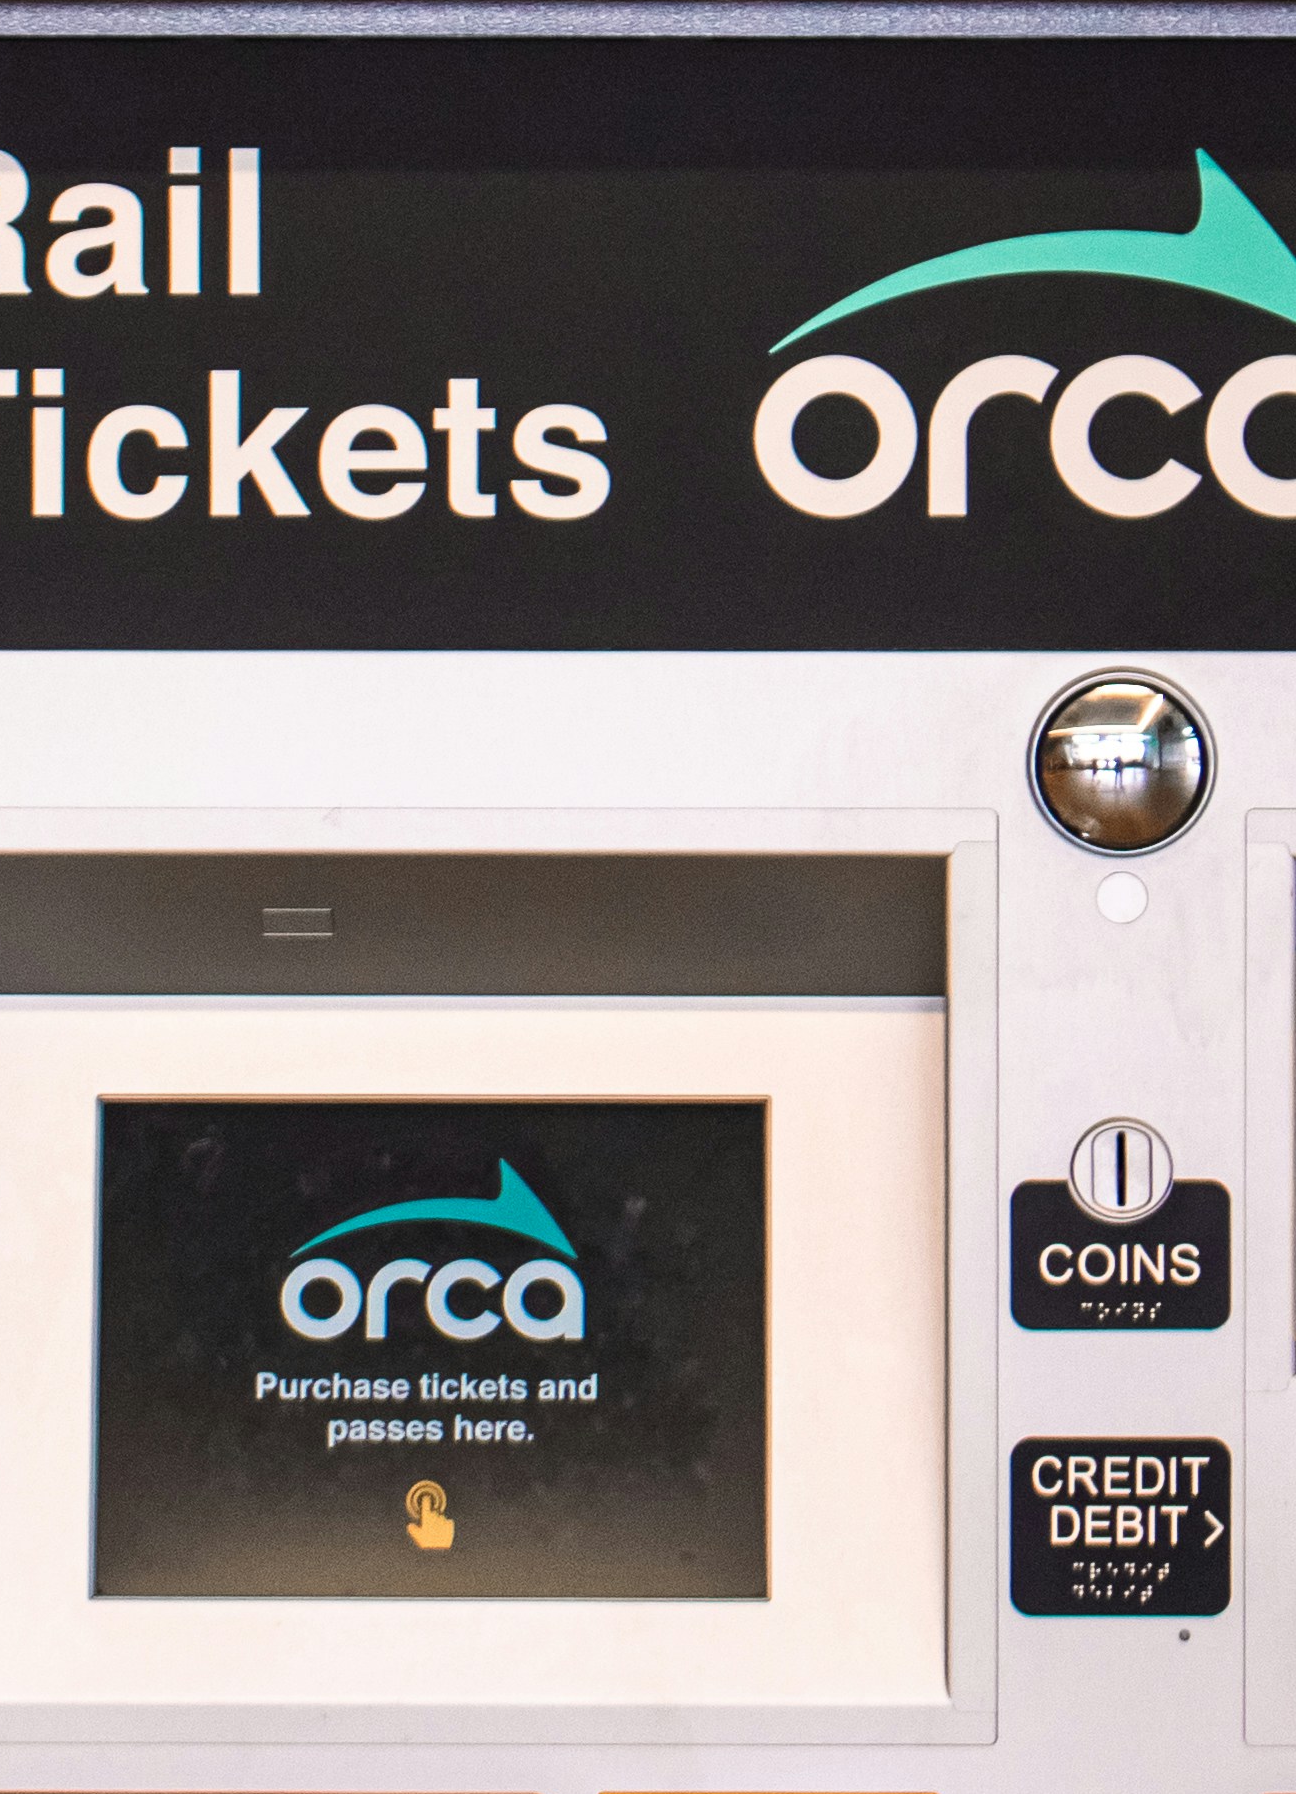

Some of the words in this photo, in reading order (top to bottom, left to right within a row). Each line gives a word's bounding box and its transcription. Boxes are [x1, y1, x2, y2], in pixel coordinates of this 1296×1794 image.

[1040, 1244, 1200, 1284] COINS
[281, 1258, 585, 1340] orca
[256, 1372, 409, 1400] Purchase
[419, 1373, 527, 1400] tickets
[538, 1374, 597, 1400] and
[328, 1420, 443, 1447] passes
[454, 1415, 533, 1441] here.
[1032, 1456, 1209, 1496] CREDIT
[1051, 1505, 1188, 1545] DEBIT
